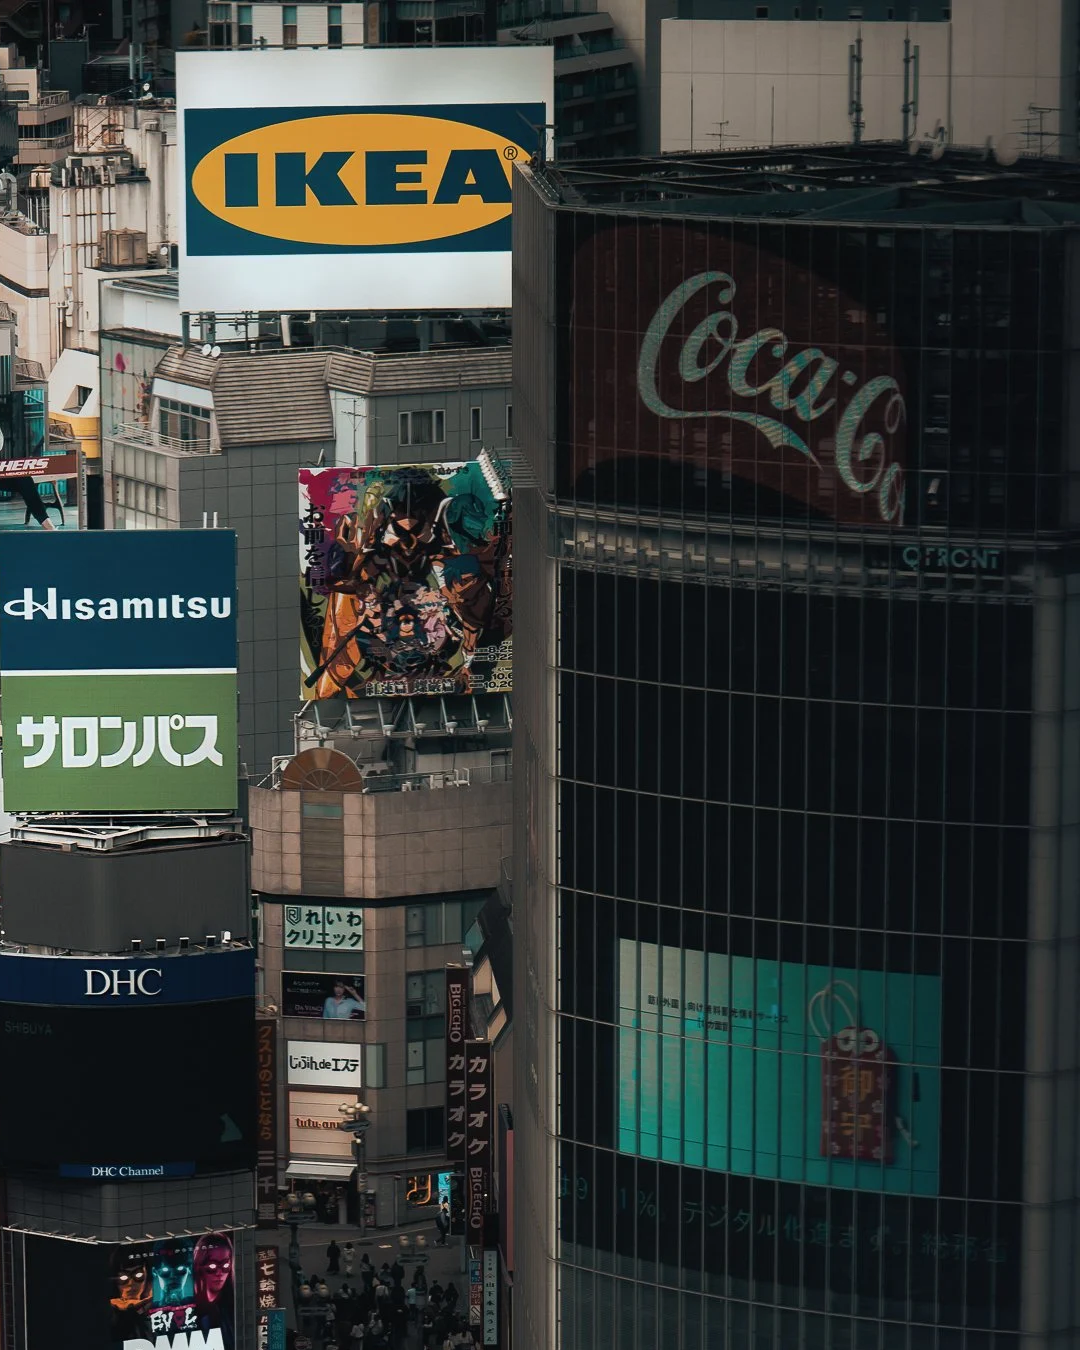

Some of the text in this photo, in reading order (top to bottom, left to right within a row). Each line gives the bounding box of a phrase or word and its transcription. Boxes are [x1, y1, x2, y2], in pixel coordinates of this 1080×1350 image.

[223, 148, 513, 208] IKEA
[3, 587, 232, 621] Hisamitsu
[16, 713, 224, 769] サロンパス
[306, 909, 362, 927] れいわ
[286, 929, 362, 948] クリニック
[84, 967, 163, 997] DHC
[468, 1056, 489, 1155] カラオケ
[91, 1165, 164, 1177] DHC Channel
